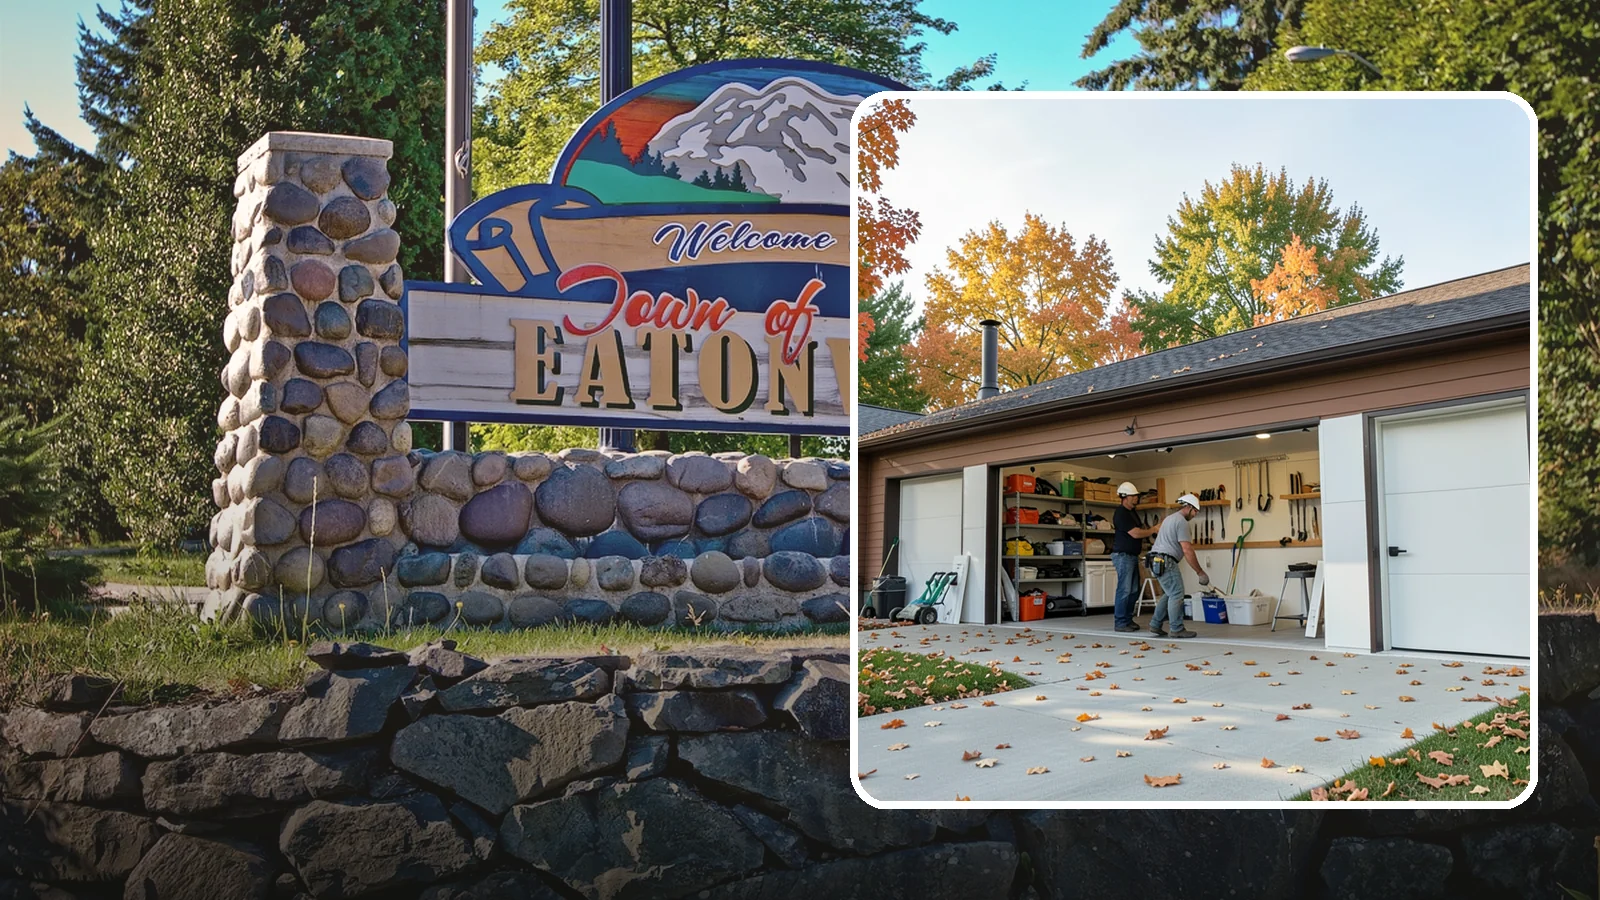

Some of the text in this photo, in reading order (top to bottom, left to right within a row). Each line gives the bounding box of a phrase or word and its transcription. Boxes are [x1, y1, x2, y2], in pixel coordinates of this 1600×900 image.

[654, 221, 836, 263] Welcome
[557, 264, 826, 365] Town of
